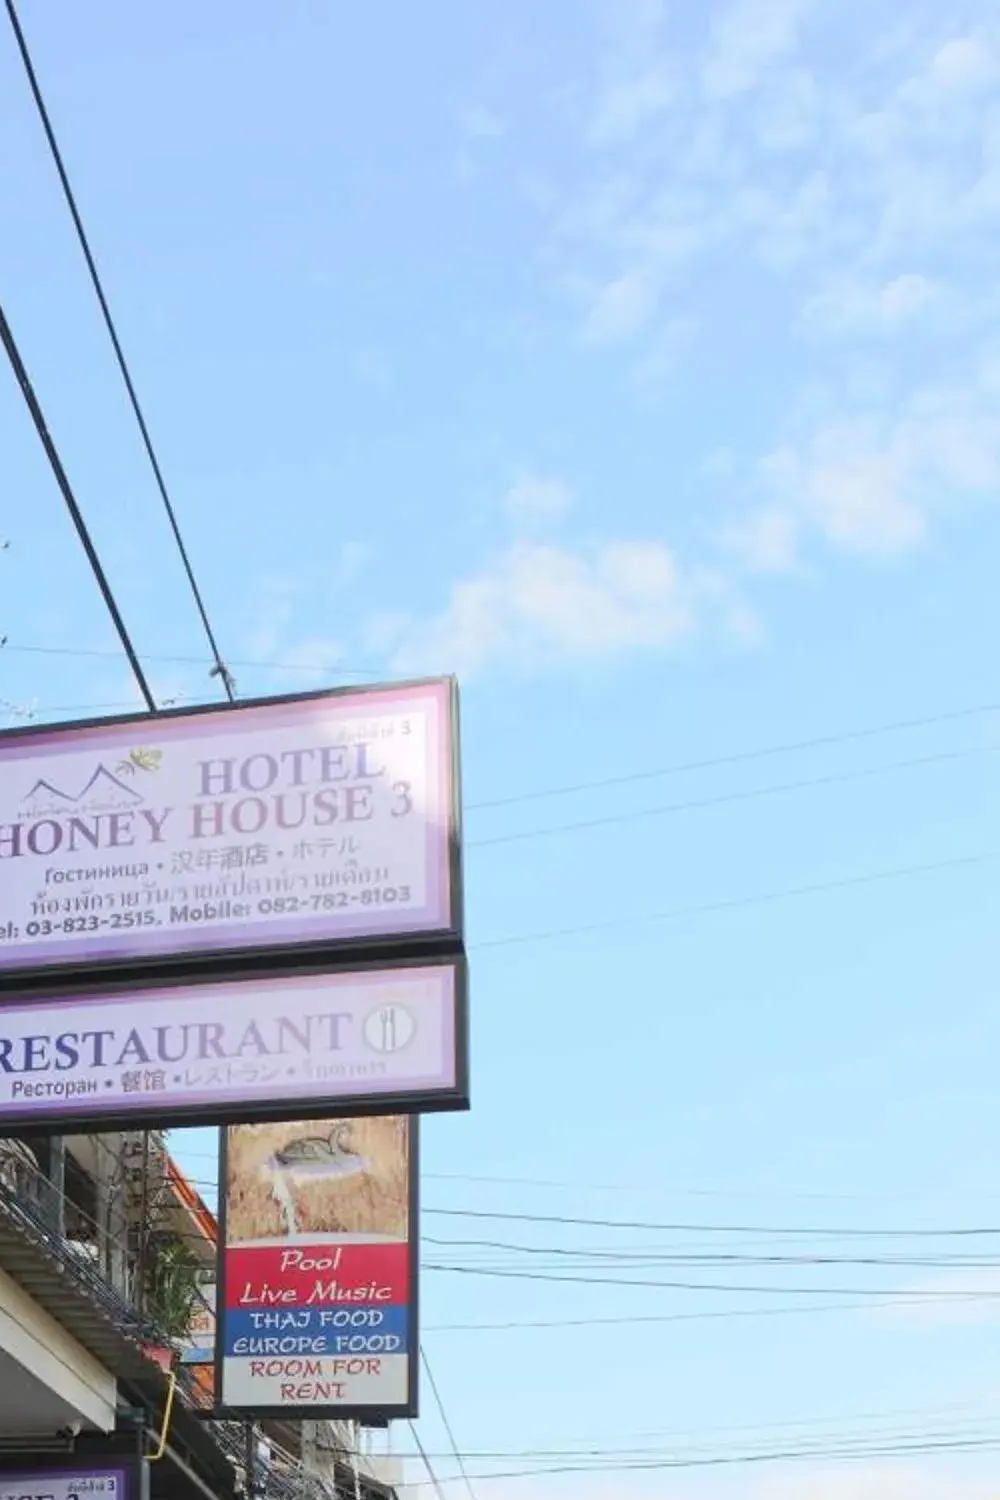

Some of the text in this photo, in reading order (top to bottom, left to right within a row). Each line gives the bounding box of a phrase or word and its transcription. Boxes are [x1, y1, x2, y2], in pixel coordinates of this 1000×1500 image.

[196, 740, 386, 797] HOTEL
[188, 784, 374, 840] HOUSE
[390, 780, 414, 818] 3
[292, 836, 361, 860] ホテル
[45, 862, 149, 885] Гостиница
[169, 900, 249, 923] Mobile:
[184, 1062, 281, 1086] レストラン
[11, 1078, 98, 1098] Ресторан
[280, 1248, 342, 1272] Pool
[240, 1280, 392, 1304] Live Music
[320, 1310, 384, 1328] FOOD
[234, 1334, 400, 1354] EUROPE FOOD
[249, 1358, 381, 1377] ROOM FOR
[280, 1382, 346, 1400] RENT
[107, 1479, 115, 1492] 3
